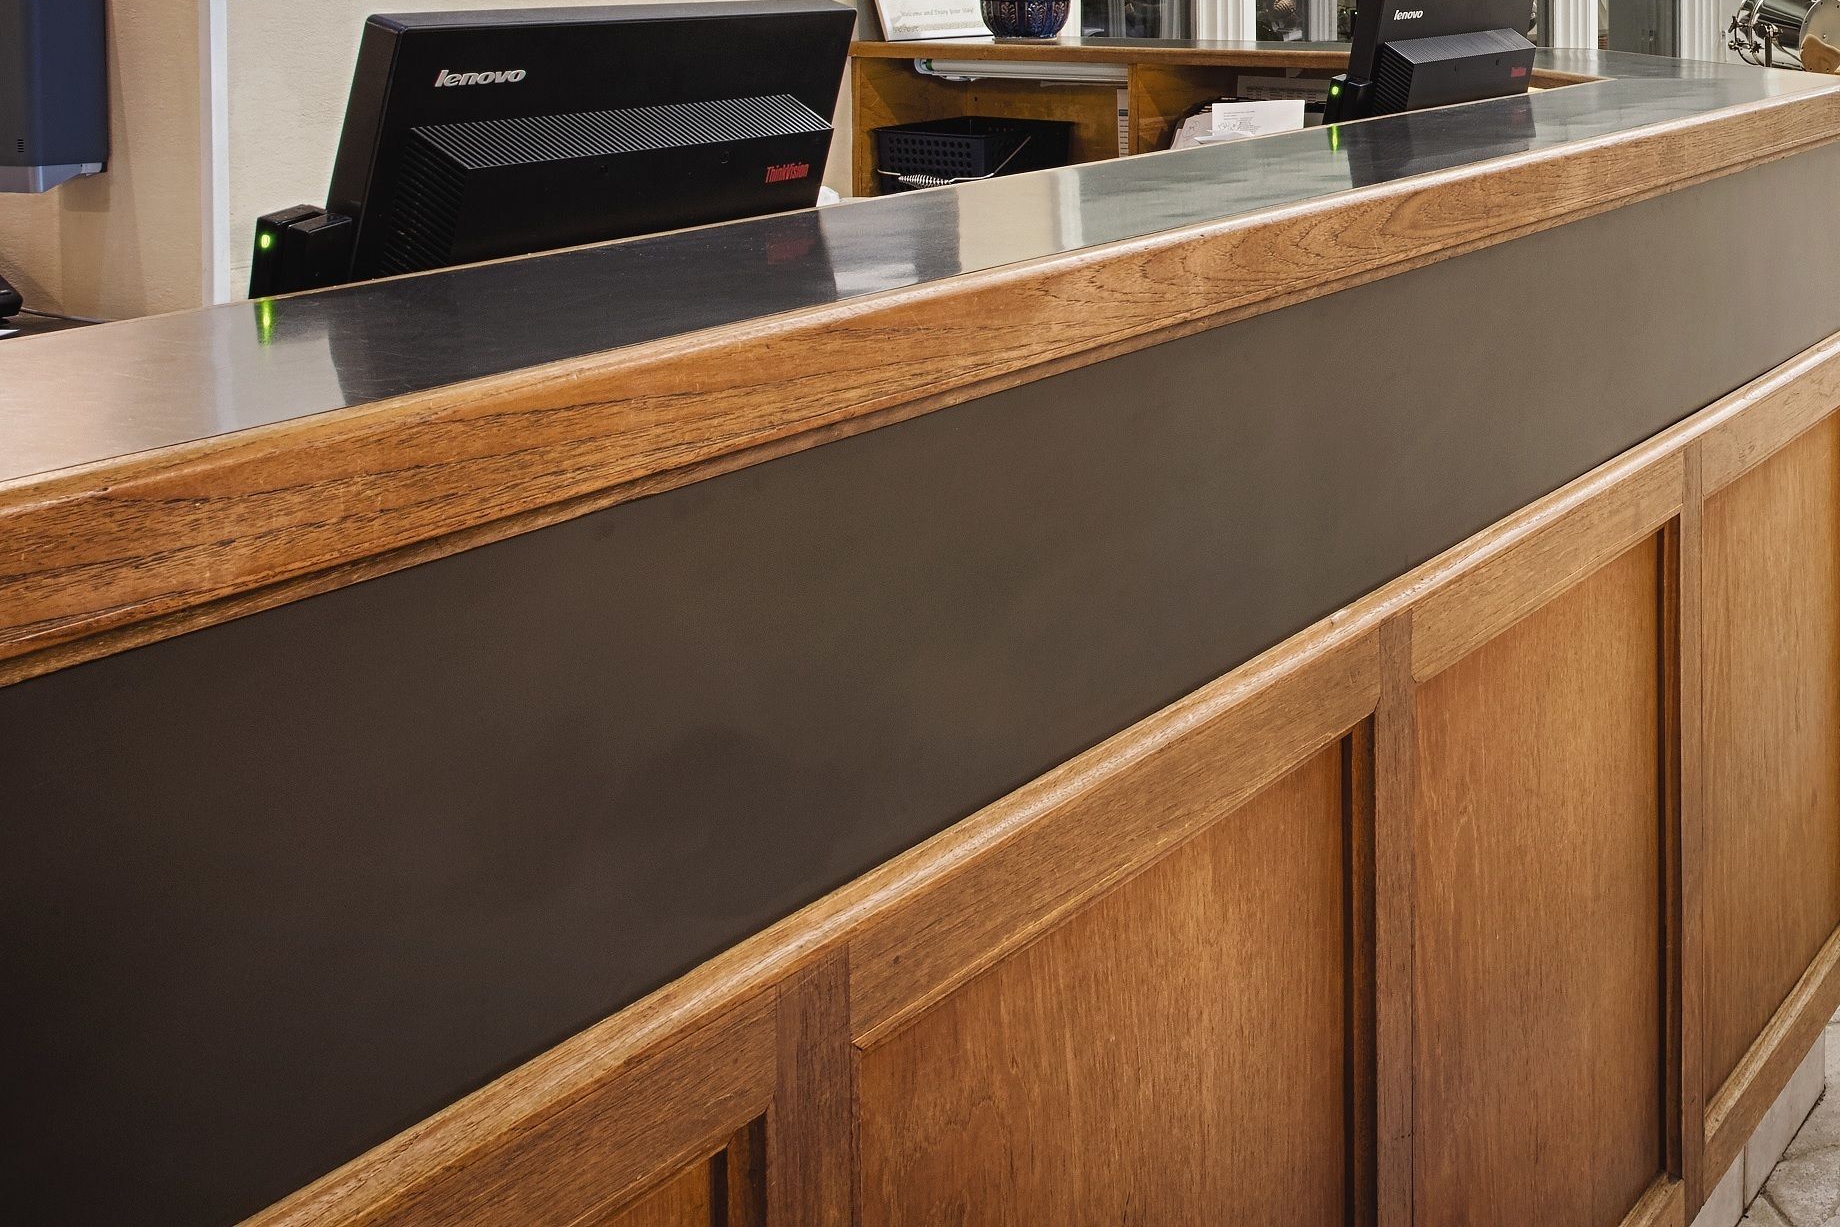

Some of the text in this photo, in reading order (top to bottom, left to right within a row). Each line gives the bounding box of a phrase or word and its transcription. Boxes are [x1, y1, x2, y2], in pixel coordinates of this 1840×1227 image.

[1393, 9, 1424, 21] lenovo
[434, 69, 527, 88] lenovo
[765, 162, 810, 183] ThinkVision
